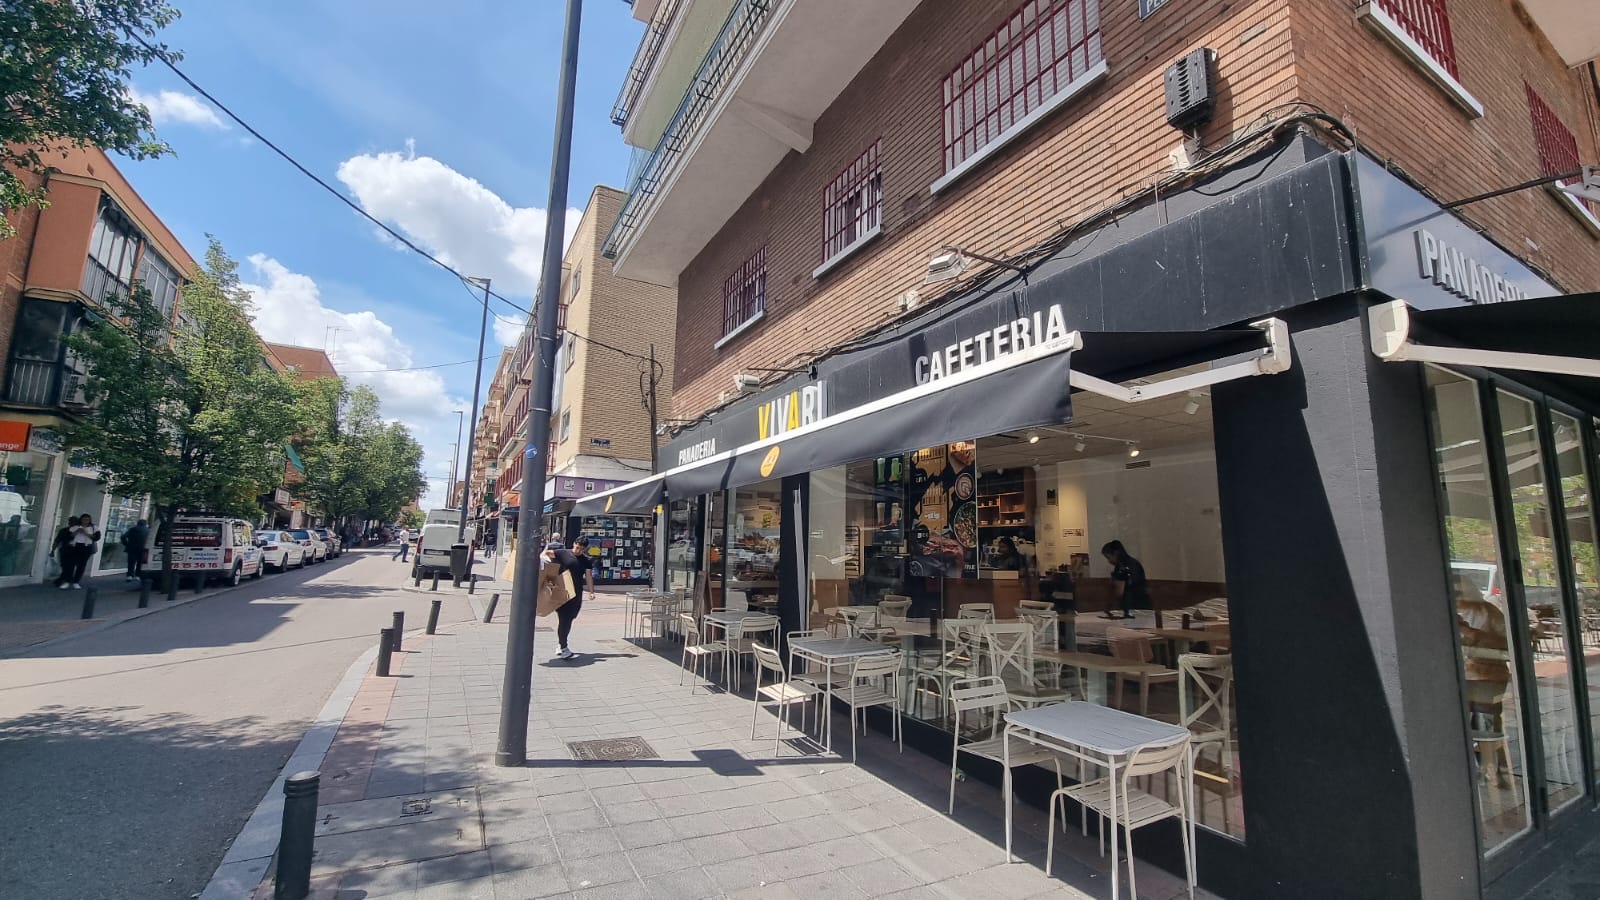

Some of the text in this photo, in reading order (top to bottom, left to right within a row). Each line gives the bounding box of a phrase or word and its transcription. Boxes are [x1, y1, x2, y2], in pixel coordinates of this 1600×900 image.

[915, 303, 1067, 386] CAFETERIA
[758, 380, 825, 441] VIVARI
[678, 438, 716, 466] PANADERIA
